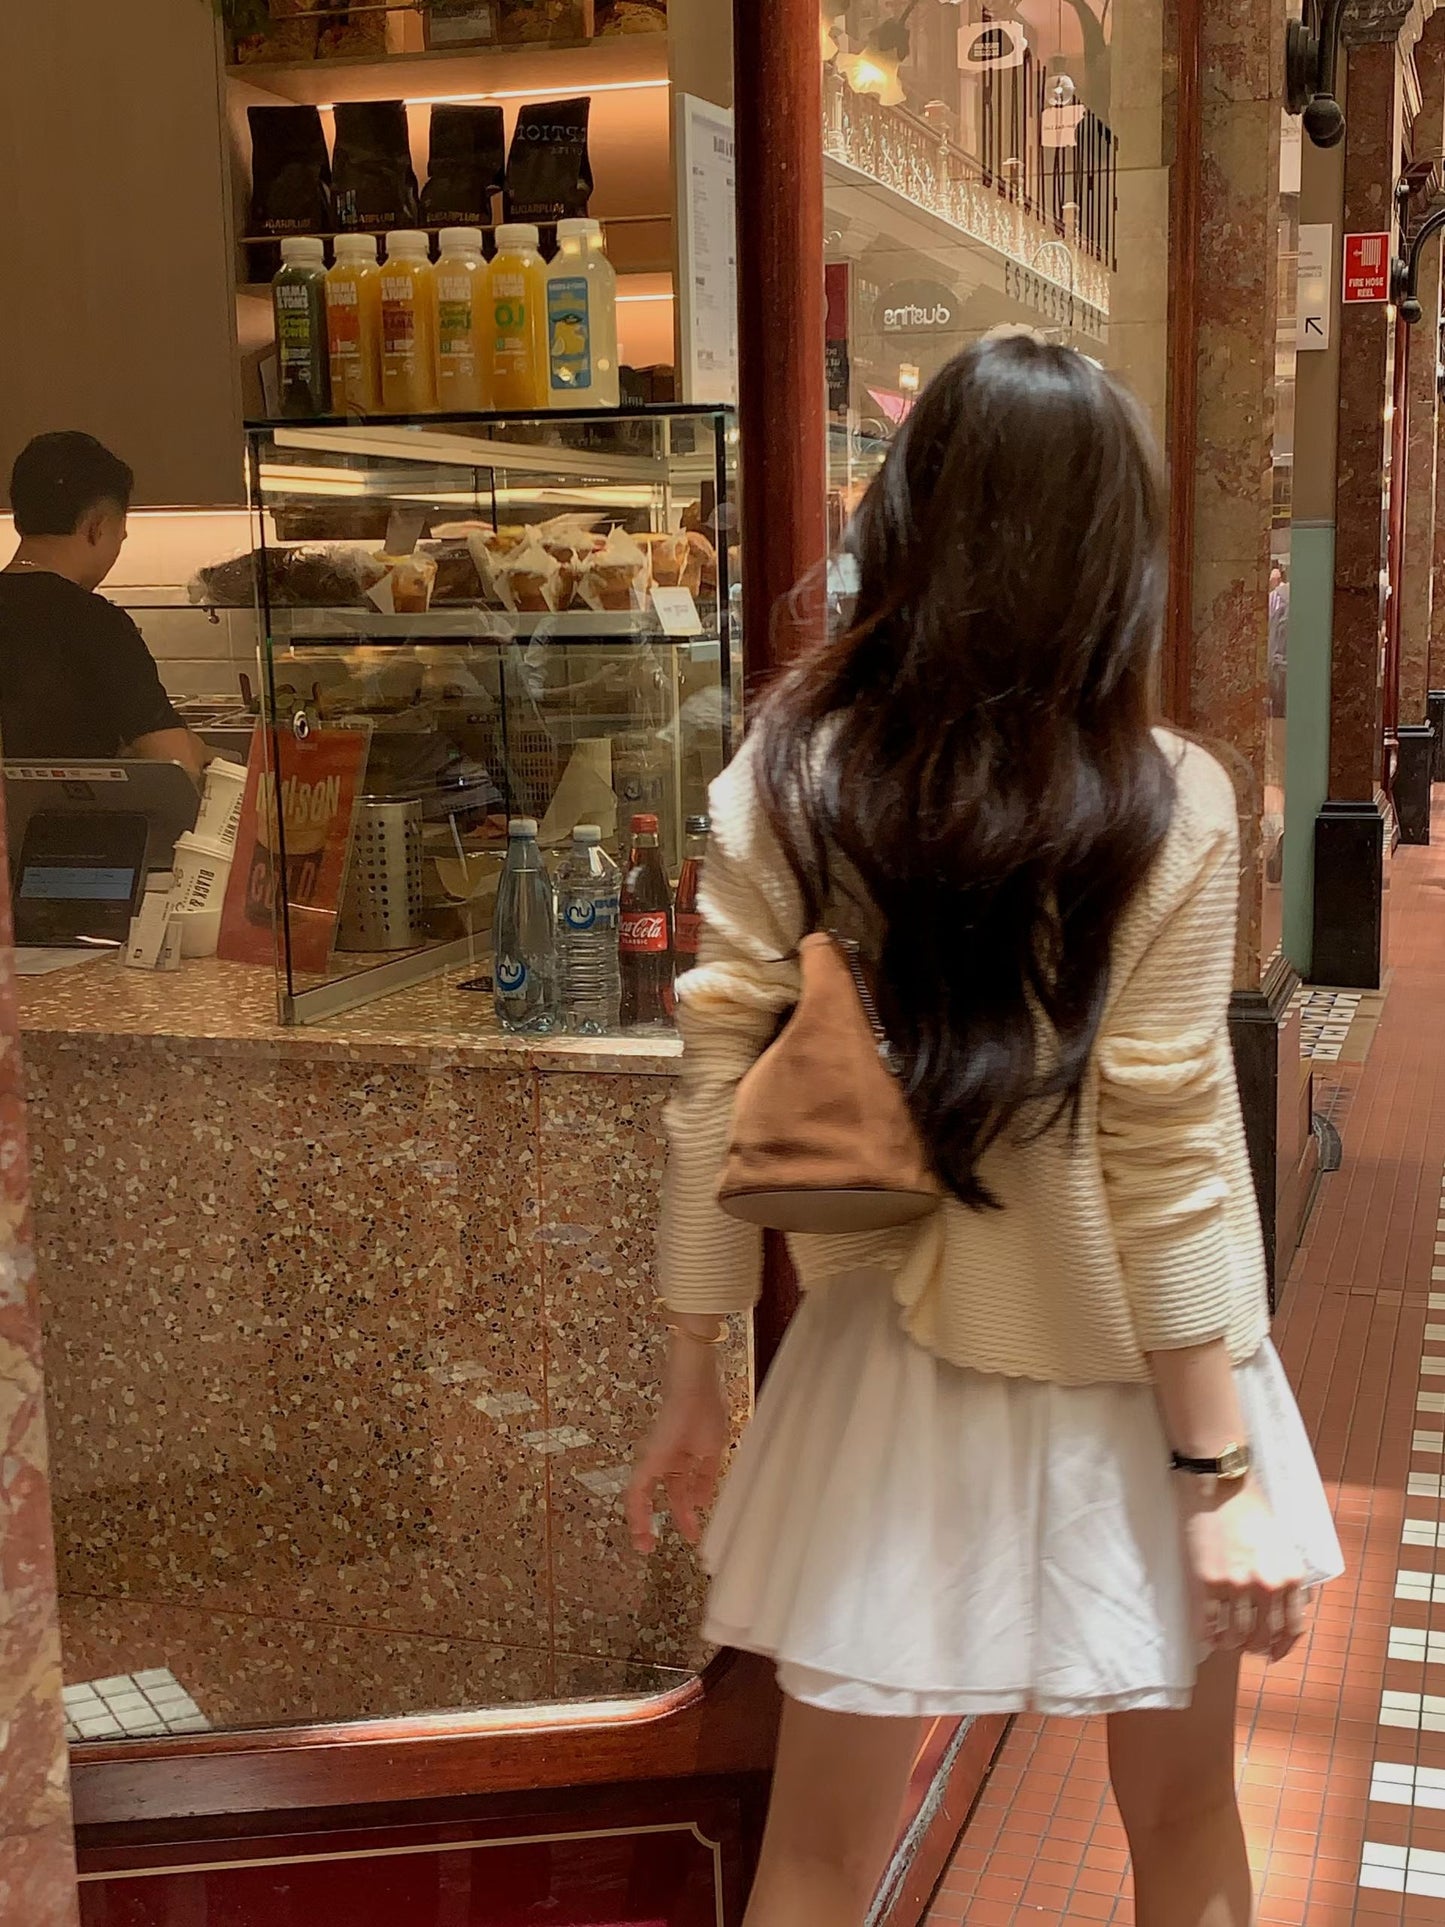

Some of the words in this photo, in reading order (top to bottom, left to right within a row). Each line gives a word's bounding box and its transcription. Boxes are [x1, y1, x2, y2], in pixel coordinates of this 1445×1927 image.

[1348, 278, 1365, 288] FIRE
[1365, 276, 1385, 287] HOSE
[1357, 287, 1375, 298] REEL
[494, 303, 525, 331] OJ
[191, 869, 215, 899] BLACK
[188, 898, 205, 908] &
